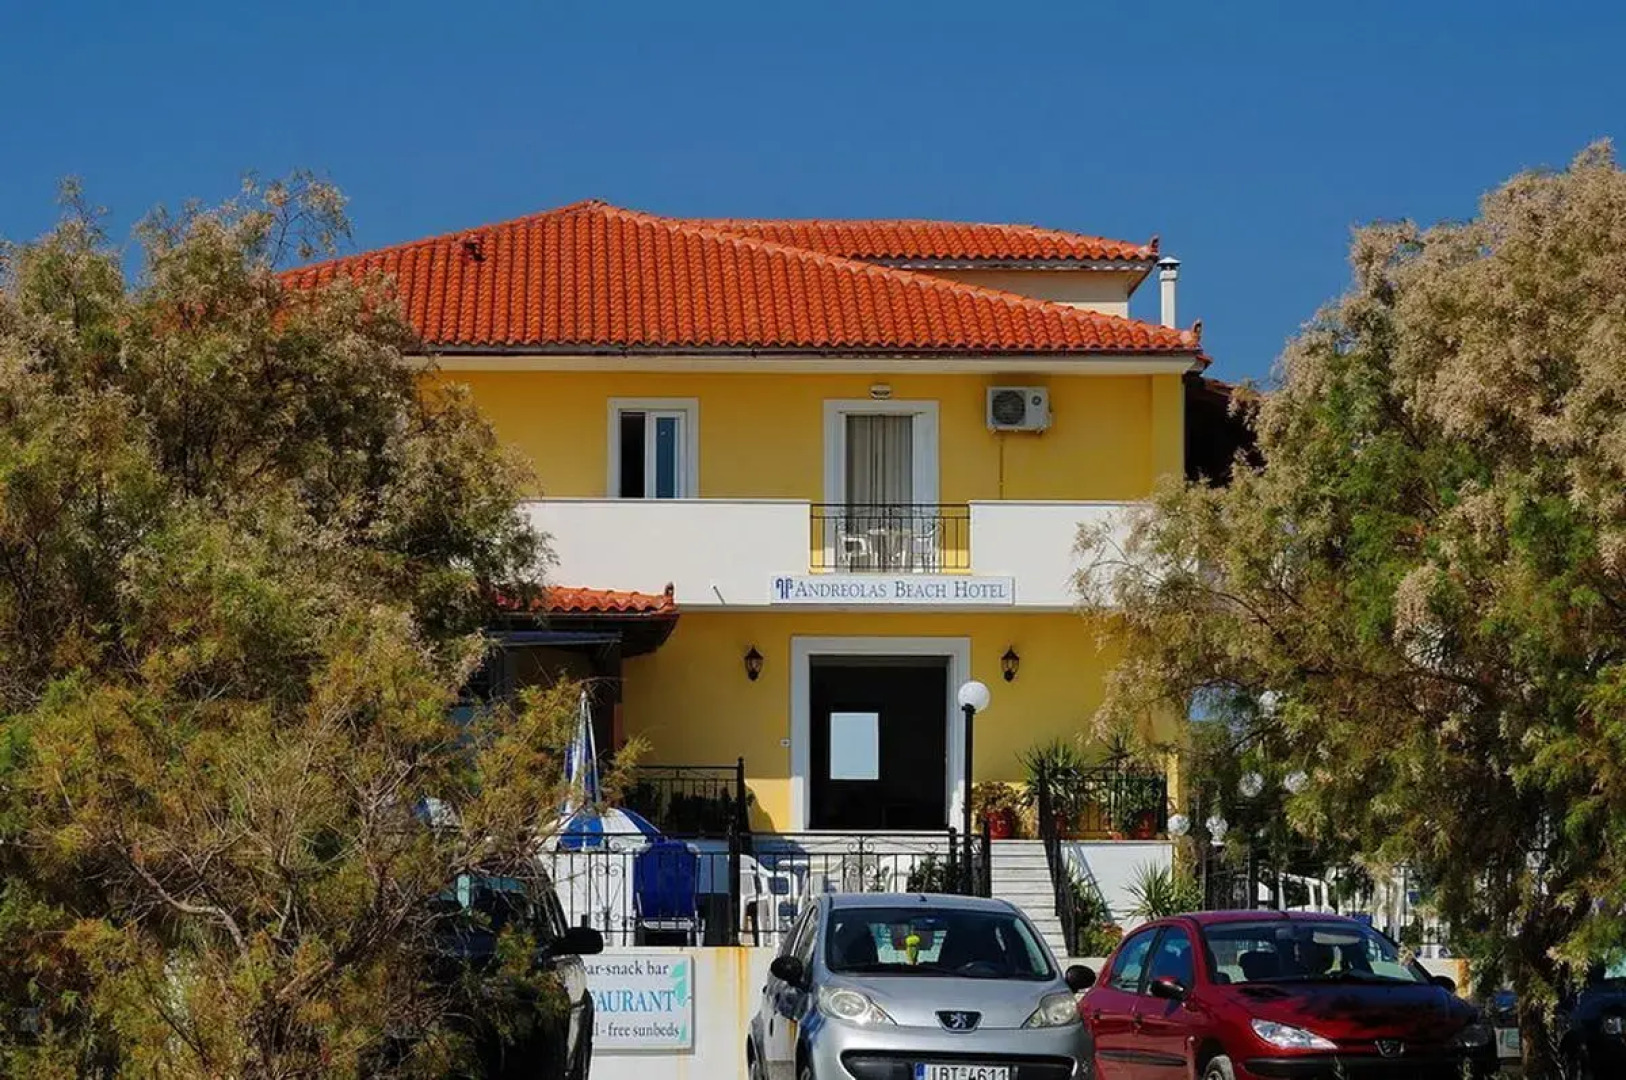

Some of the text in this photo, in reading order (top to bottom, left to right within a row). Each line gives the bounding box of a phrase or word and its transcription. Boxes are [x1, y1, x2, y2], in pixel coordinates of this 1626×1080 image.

[795, 580, 1006, 599] ANDREOLAS BEACH HOTEL
[646, 960, 669, 975] bar
[608, 1022, 630, 1036] free
[632, 1022, 680, 1038] sunbeds
